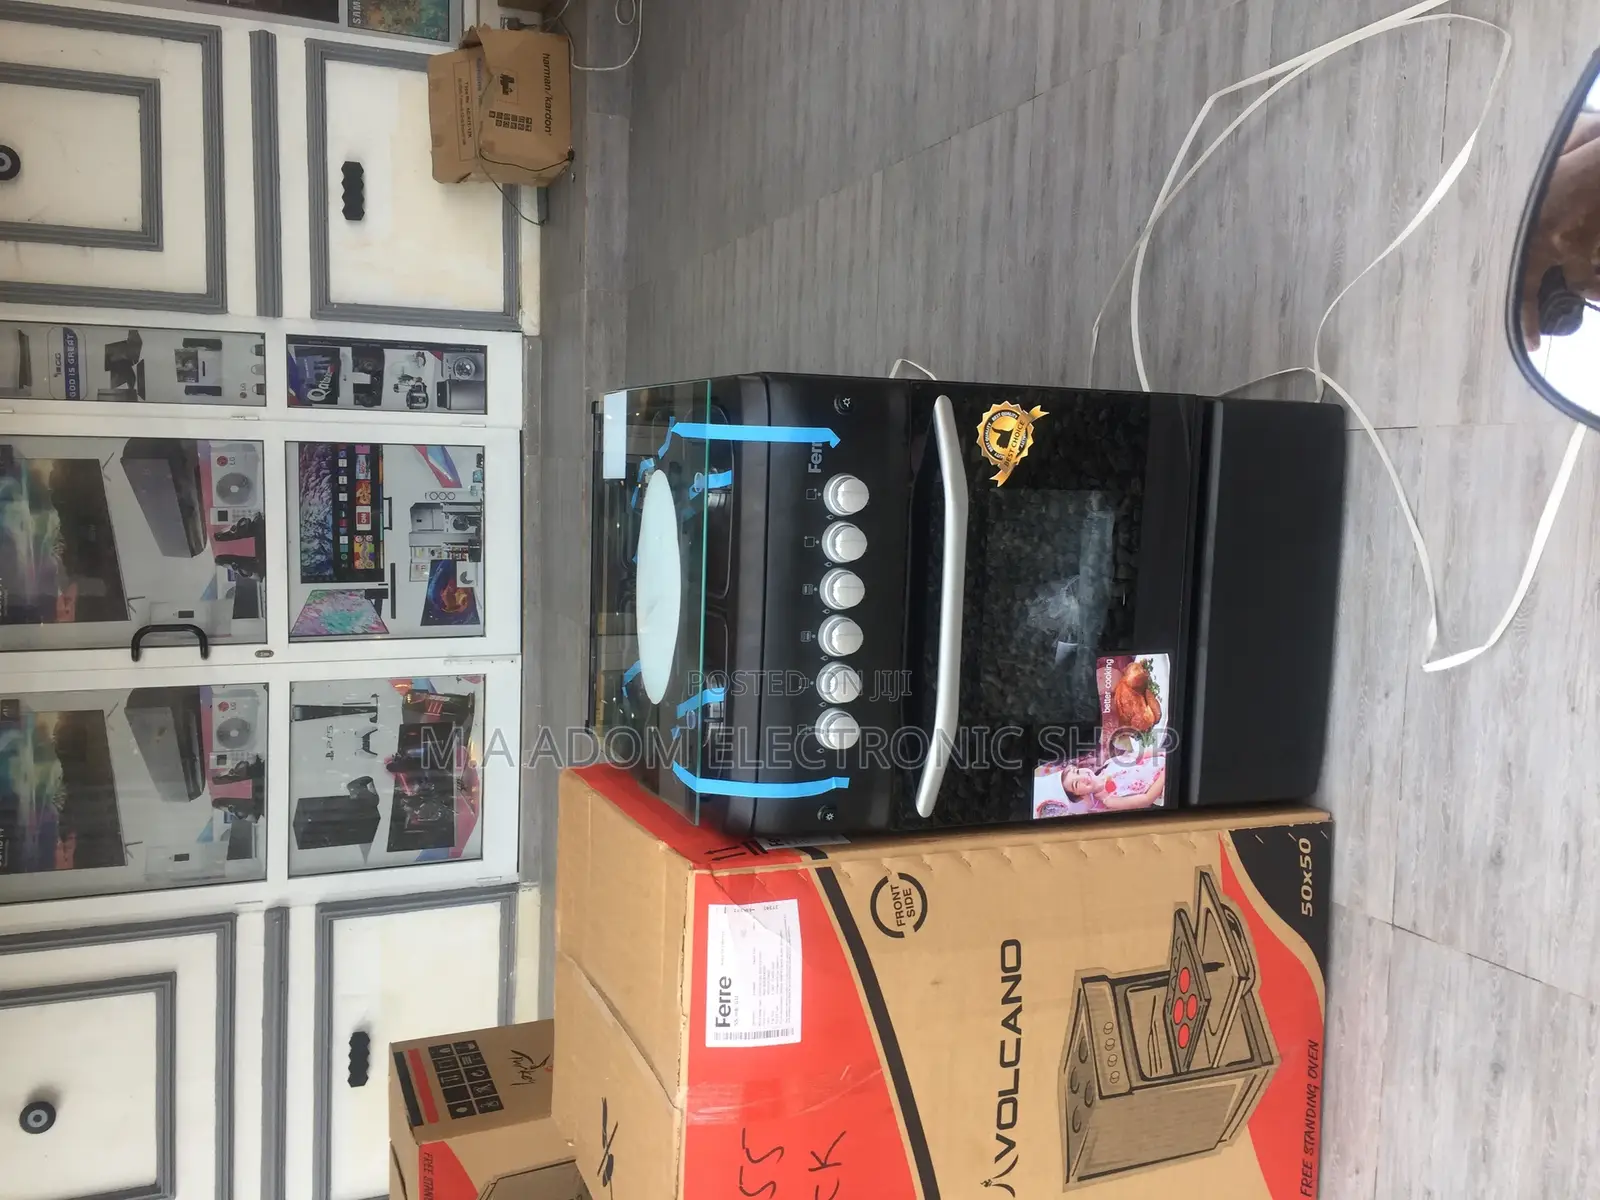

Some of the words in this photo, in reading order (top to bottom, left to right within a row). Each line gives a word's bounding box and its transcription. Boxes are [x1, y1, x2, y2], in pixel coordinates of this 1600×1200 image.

[352, 0, 361, 24] SAM
[69, 367, 75, 376] IS
[984, 422, 992, 442] QUALITY
[1004, 449, 1014, 466] BEST
[1011, 419, 1025, 448] CHOICE
[230, 456, 236, 466] LG
[808, 442, 822, 473] Ferr
[1104, 659, 1114, 688] cooking
[230, 701, 237, 711] LG
[1103, 692, 1111, 713] better
[1299, 837, 1313, 917] 50x50
[890, 884, 906, 927] FRONT
[903, 888, 915, 917] SIDE
[715, 976, 732, 1028] Ferre
[993, 938, 1023, 1164] VOLCANO
[1307, 1039, 1319, 1079] OVEN
[1303, 1083, 1319, 1156] STANDING
[424, 1152, 434, 1174] FREE
[1300, 1159, 1313, 1197] FREE
